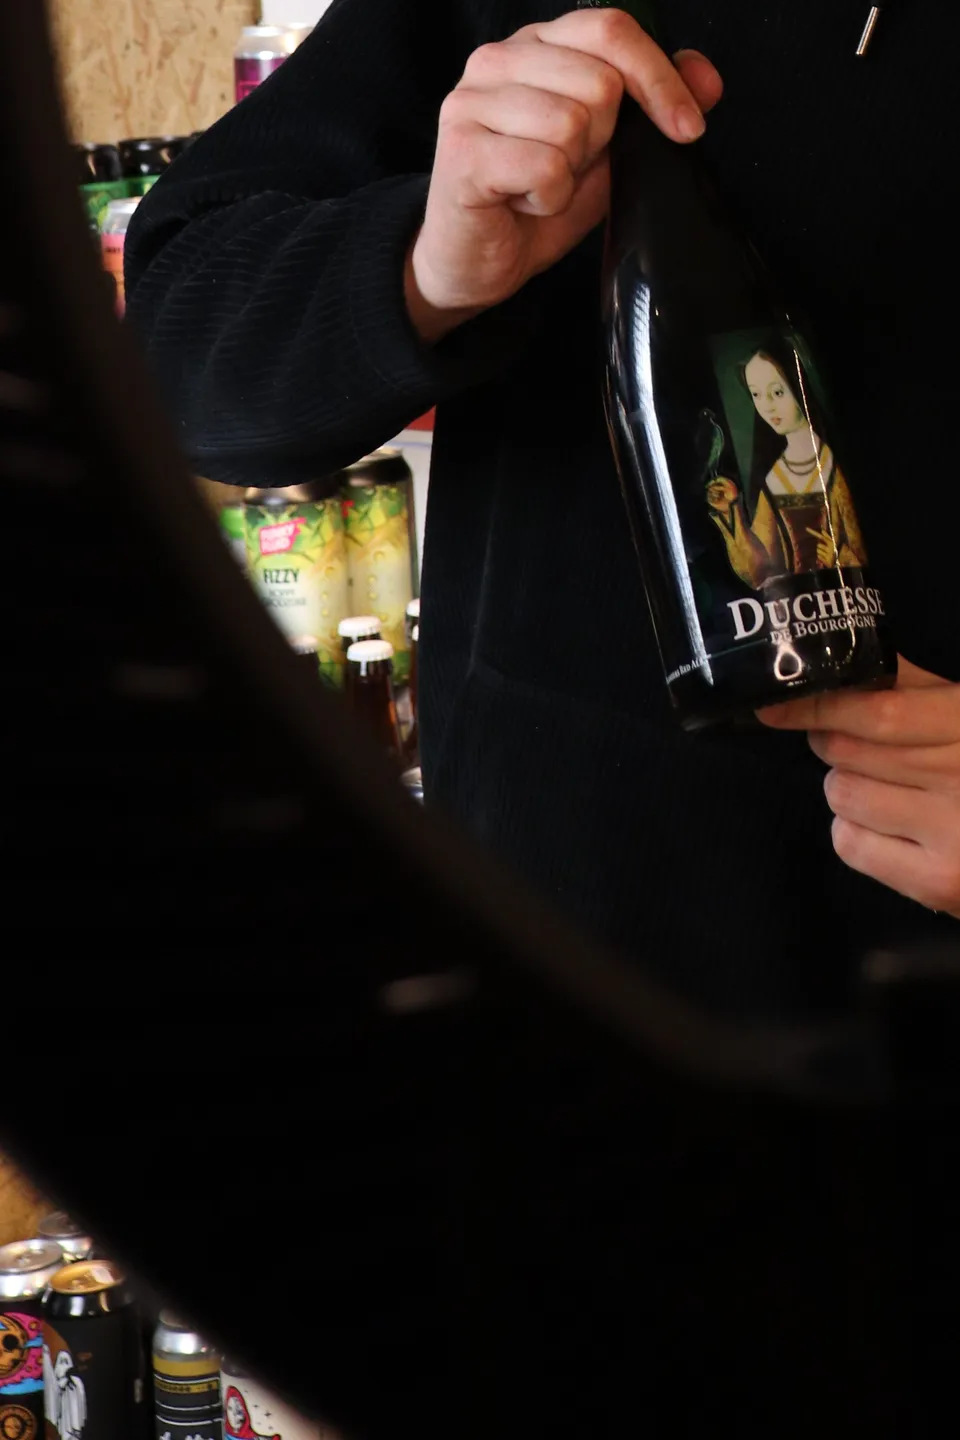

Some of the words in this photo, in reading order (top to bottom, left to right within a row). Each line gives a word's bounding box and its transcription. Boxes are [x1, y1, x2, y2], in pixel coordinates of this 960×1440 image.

[263, 567, 300, 586] FIZZY
[727, 586, 886, 641] DUCHESSE
[794, 614, 877, 638] BOURGOGNE
